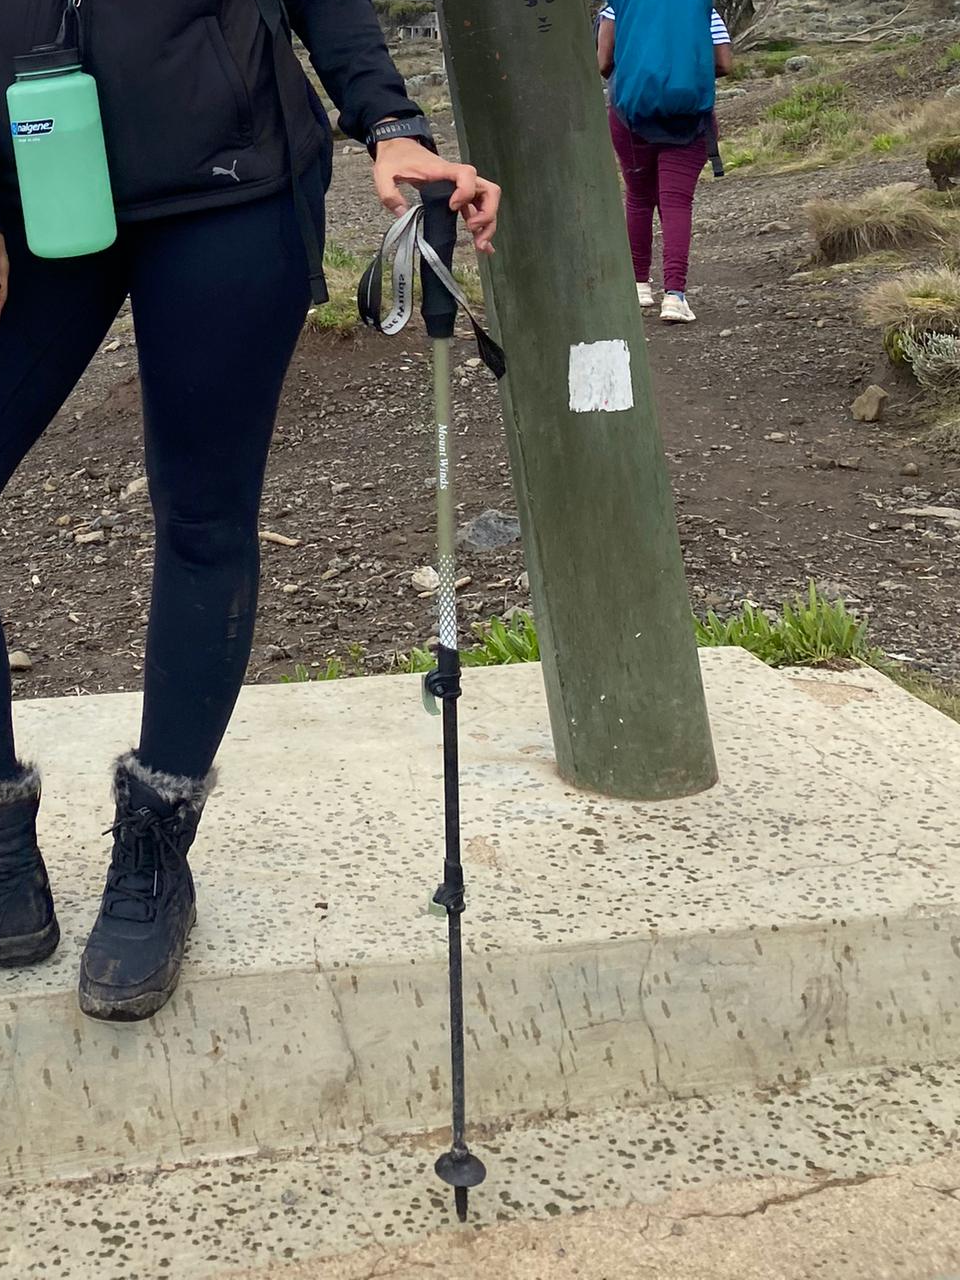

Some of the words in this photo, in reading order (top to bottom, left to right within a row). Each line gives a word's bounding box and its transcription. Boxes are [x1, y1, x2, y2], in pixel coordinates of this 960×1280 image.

[17, 122, 50, 135] nalgene
[437, 423, 448, 456] Mount
[438, 457, 450, 491] Winds
